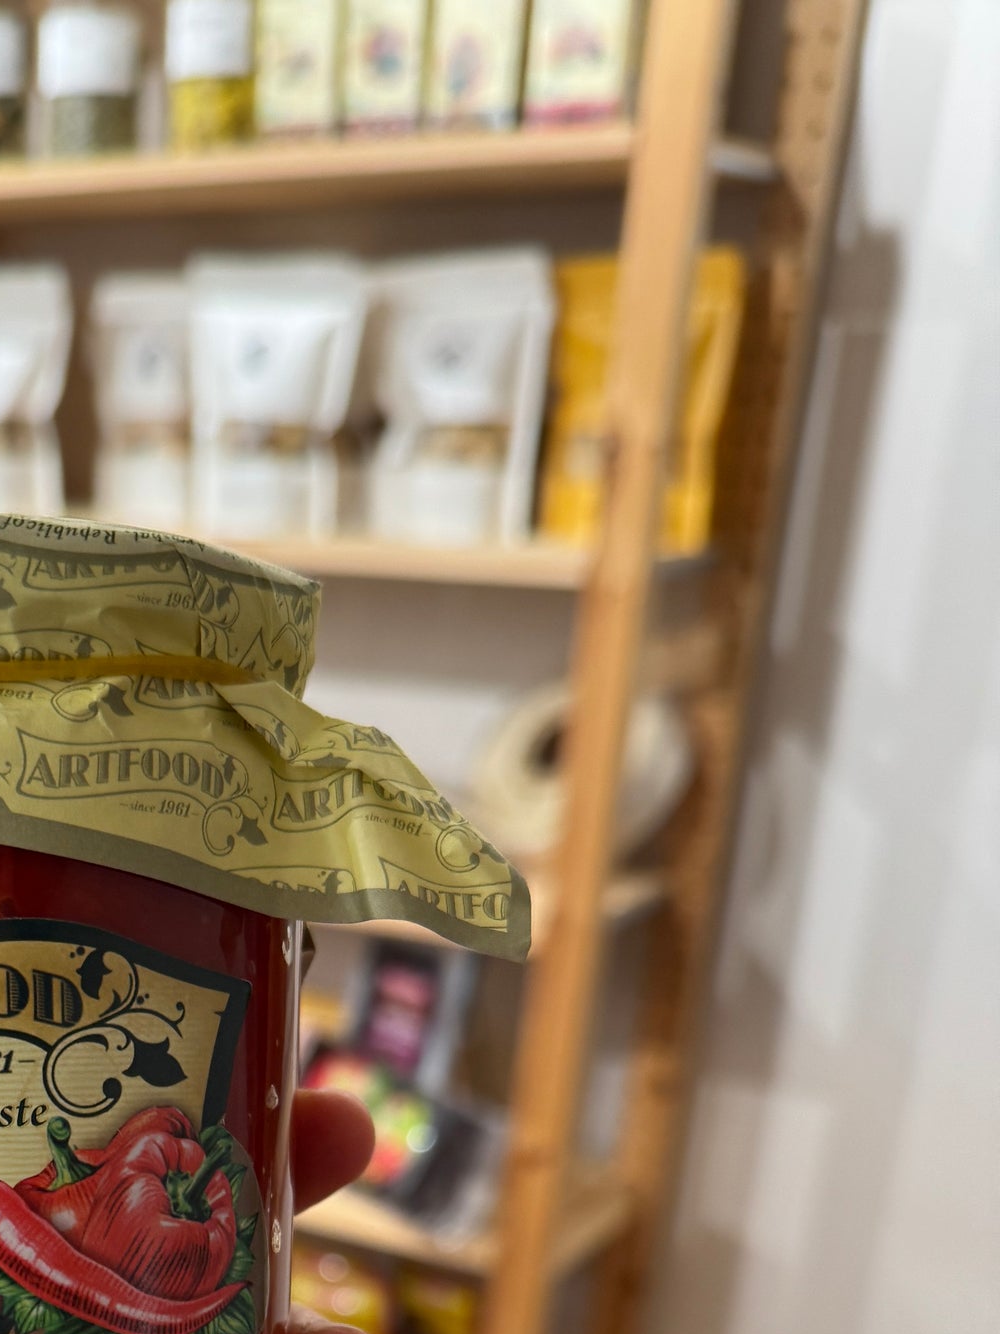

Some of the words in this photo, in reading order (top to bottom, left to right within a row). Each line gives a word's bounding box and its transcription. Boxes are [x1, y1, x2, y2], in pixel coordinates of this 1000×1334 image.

[165, 591, 197, 609] 1961
[26, 747, 225, 800] ARTFOOD
[129, 800, 156, 813] since
[158, 798, 192, 818] 1961
[364, 814, 390, 825] since
[391, 817, 424, 837] 1961
